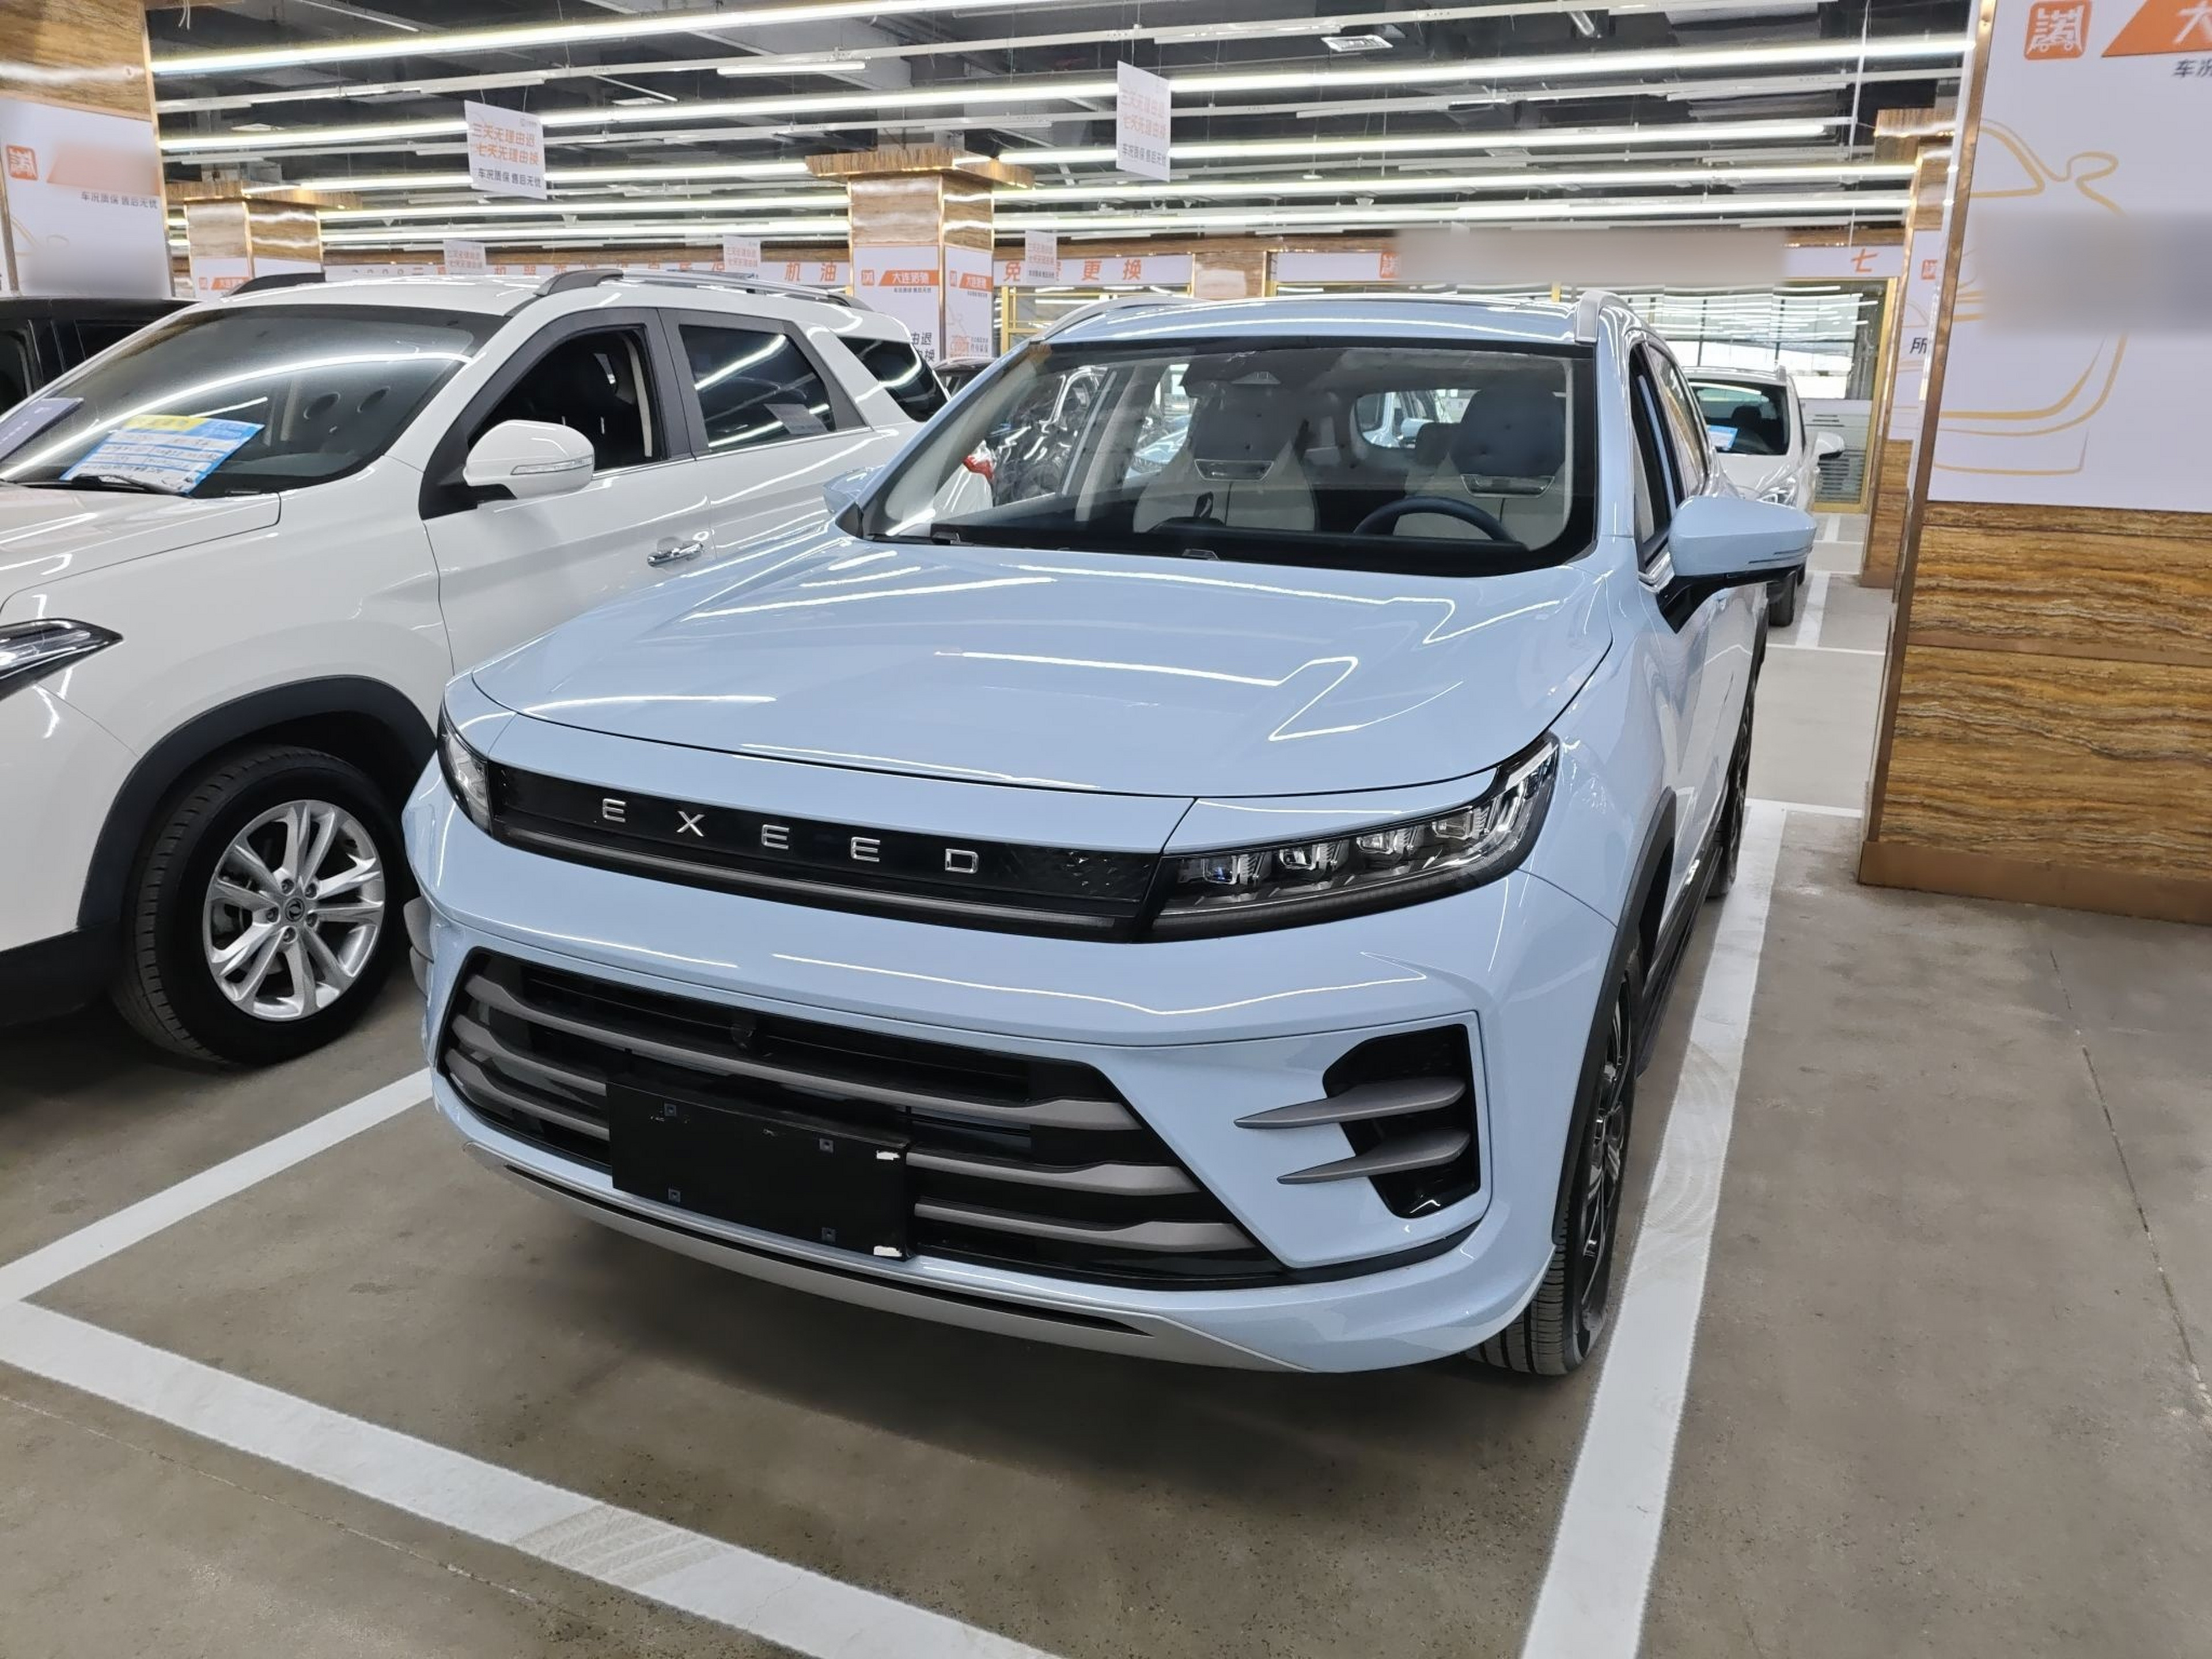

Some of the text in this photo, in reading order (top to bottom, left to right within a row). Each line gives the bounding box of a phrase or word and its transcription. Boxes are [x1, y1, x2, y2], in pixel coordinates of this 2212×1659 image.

[472, 122, 536, 147] 三天无理由退
[476, 142, 539, 165] 七天无理由换
[81, 191, 119, 205] 车况质保
[1851, 248, 1879, 272] 七
[1910, 337, 1928, 354] 所
[603, 798, 978, 874] EXEED
